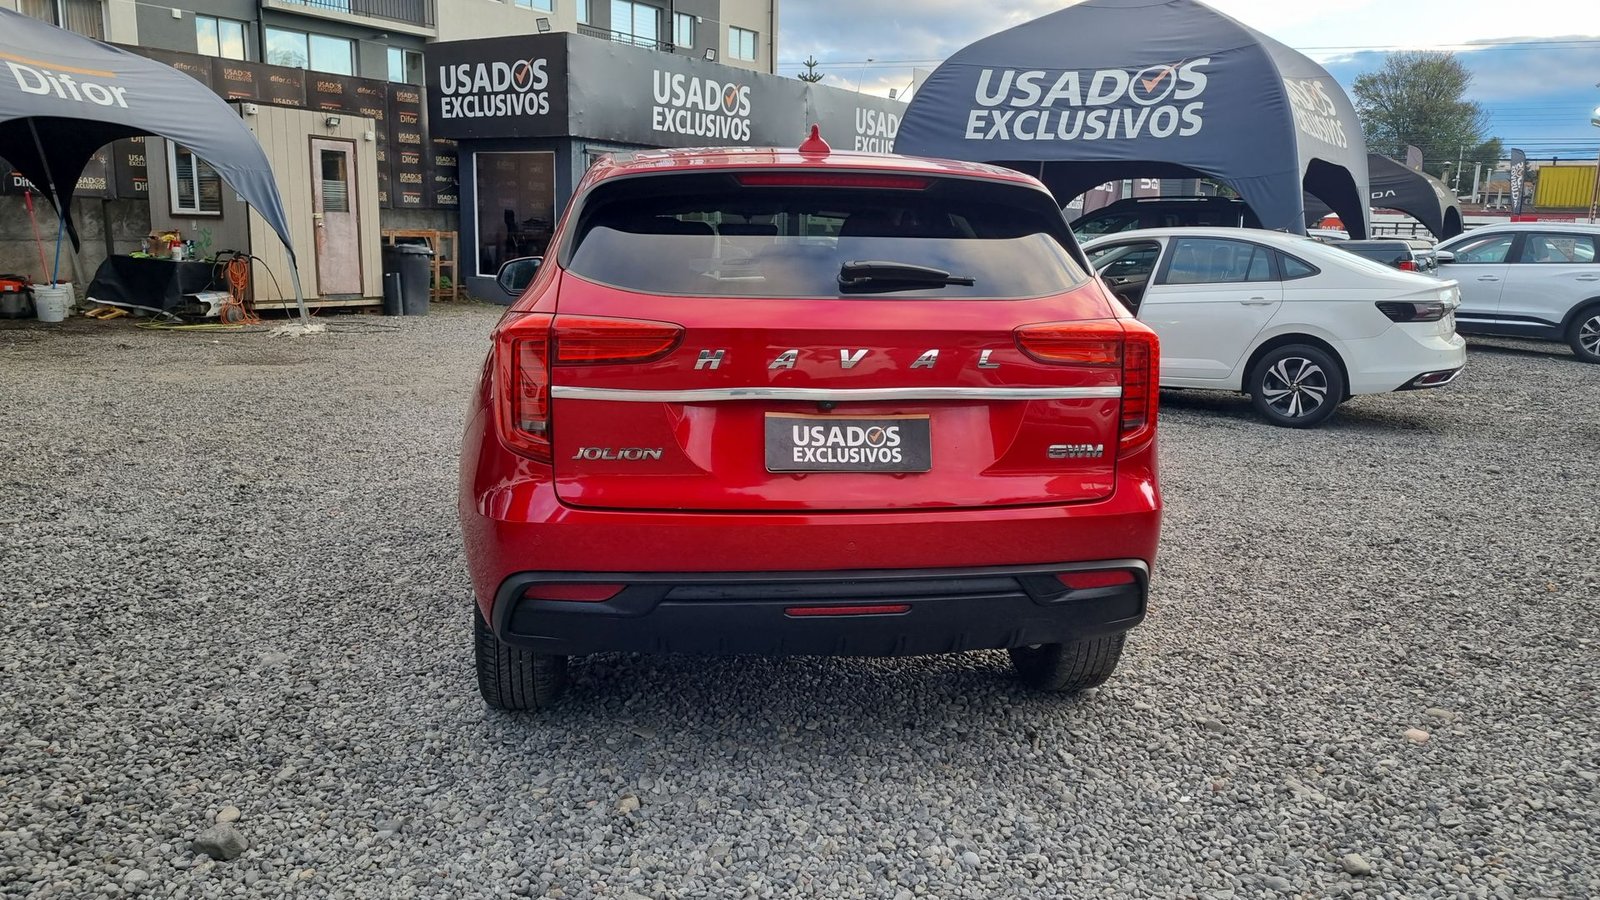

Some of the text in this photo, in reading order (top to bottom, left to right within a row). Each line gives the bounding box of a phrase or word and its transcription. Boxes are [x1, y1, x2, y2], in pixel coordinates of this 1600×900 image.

[5, 61, 129, 108] Difor
[439, 57, 549, 95] USADOS
[975, 57, 1210, 106] USADOS
[653, 69, 751, 117] USADOS
[441, 91, 549, 119] EXCLUSIVOS
[400, 115, 417, 124] Difor
[652, 106, 751, 142] EXCLUSIVOS
[965, 101, 1204, 140] EXCLUSIVOS
[402, 155, 419, 164] Difor
[403, 195, 420, 203] Difor
[693, 349, 1001, 370] HAVAL
[792, 425, 901, 447] USADOS
[572, 447, 662, 460] JOLION
[793, 447, 902, 463] EXCLUSIVOS
[1048, 444, 1104, 459] GWM
